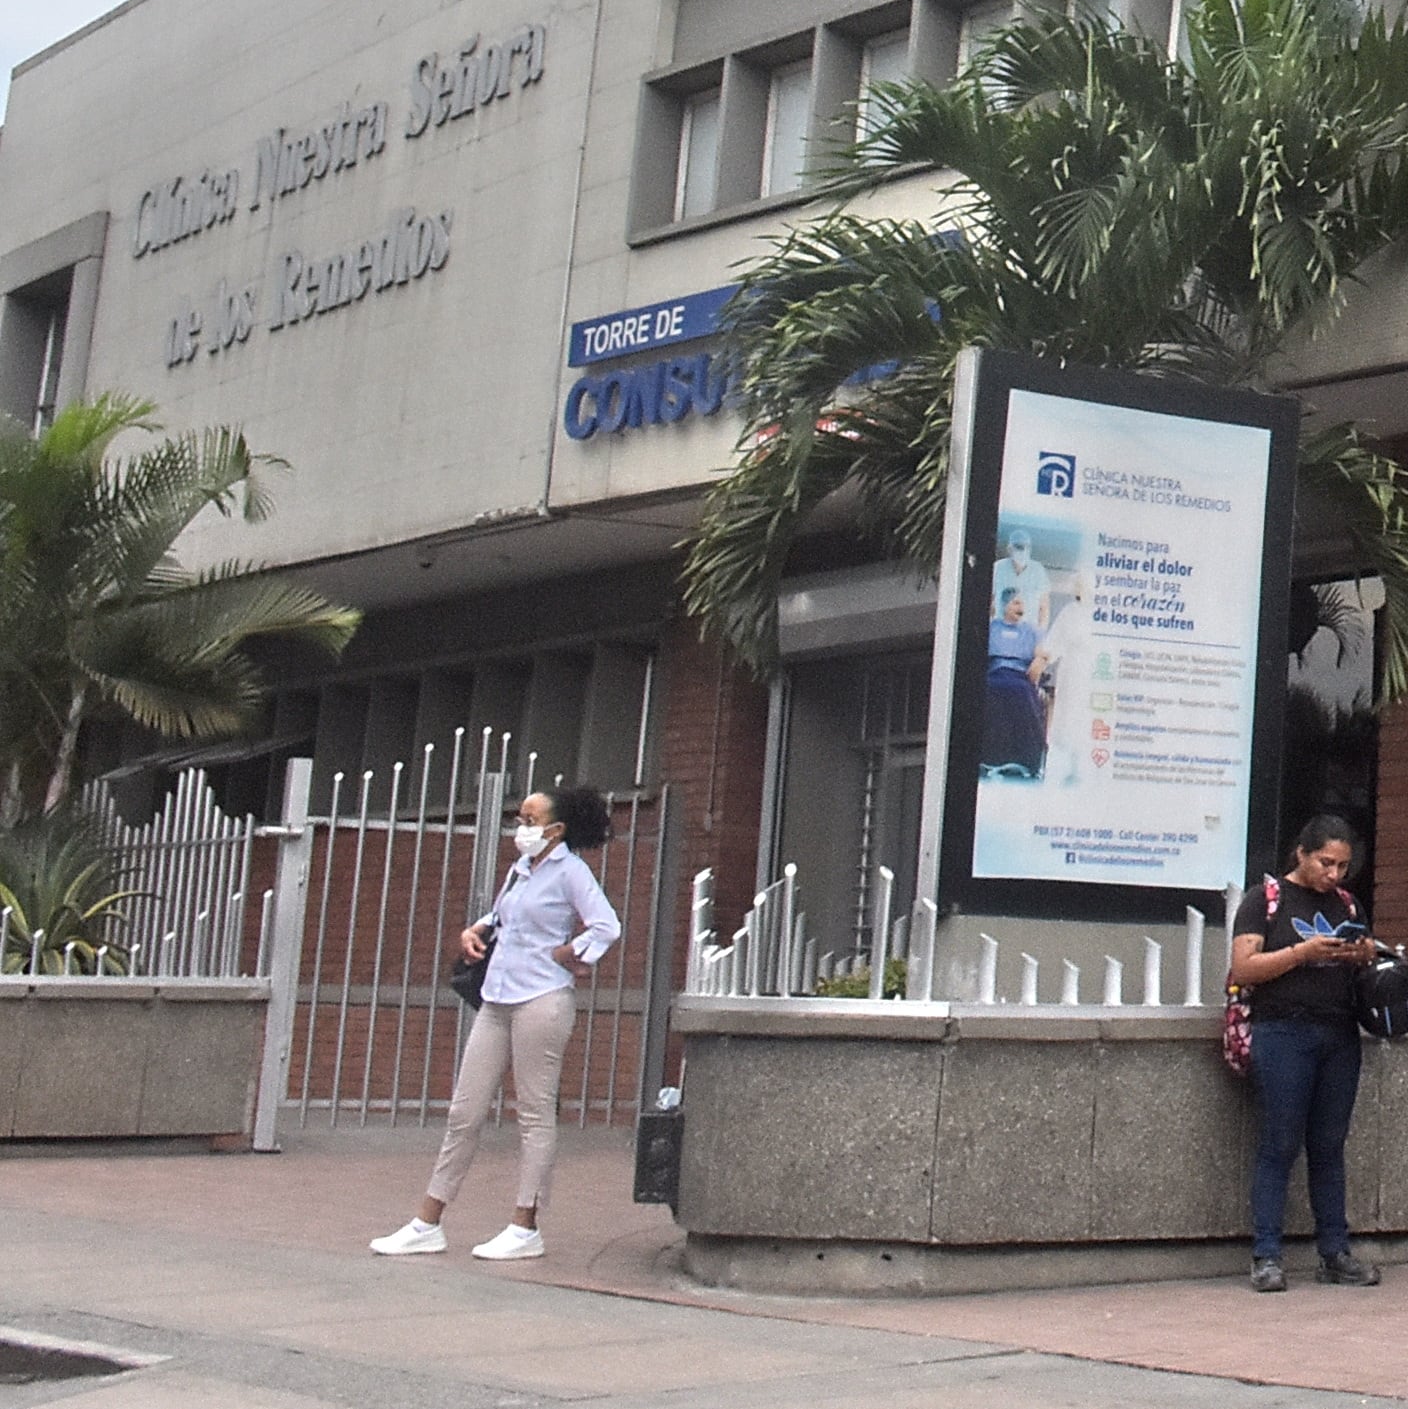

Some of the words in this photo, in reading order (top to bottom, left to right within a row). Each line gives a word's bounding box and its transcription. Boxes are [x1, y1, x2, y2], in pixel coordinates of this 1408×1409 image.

[248, 99, 389, 213] Nuestra
[404, 24, 547, 141] Señora
[268, 205, 455, 334] Remedios
[583, 313, 652, 356] TORRE
[655, 305, 685, 340] DE
[1082, 465, 1129, 485] CLÍNICA
[1131, 473, 1183, 492] NUESTRA
[1132, 488, 1148, 502] DE
[1151, 491, 1173, 505] LOS
[1175, 494, 1232, 513] REMEDIOS
[1098, 532, 1143, 551] Nacimos
[1146, 541, 1169, 556] para
[1096, 553, 1139, 571] aliviar
[1142, 558, 1155, 573] el
[1158, 559, 1193, 576] dolor
[1095, 574, 1101, 588] y
[1104, 574, 1148, 589] sembrar
[1150, 577, 1161, 591] la
[1163, 583, 1181, 596] paz
[1094, 594, 1108, 606] en
[1110, 593, 1121, 607] el
[1122, 593, 1185, 613] corazón
[1093, 608, 1108, 622] de
[1111, 609, 1128, 625] los
[1131, 614, 1154, 629] que
[1157, 615, 1194, 631] sufren
